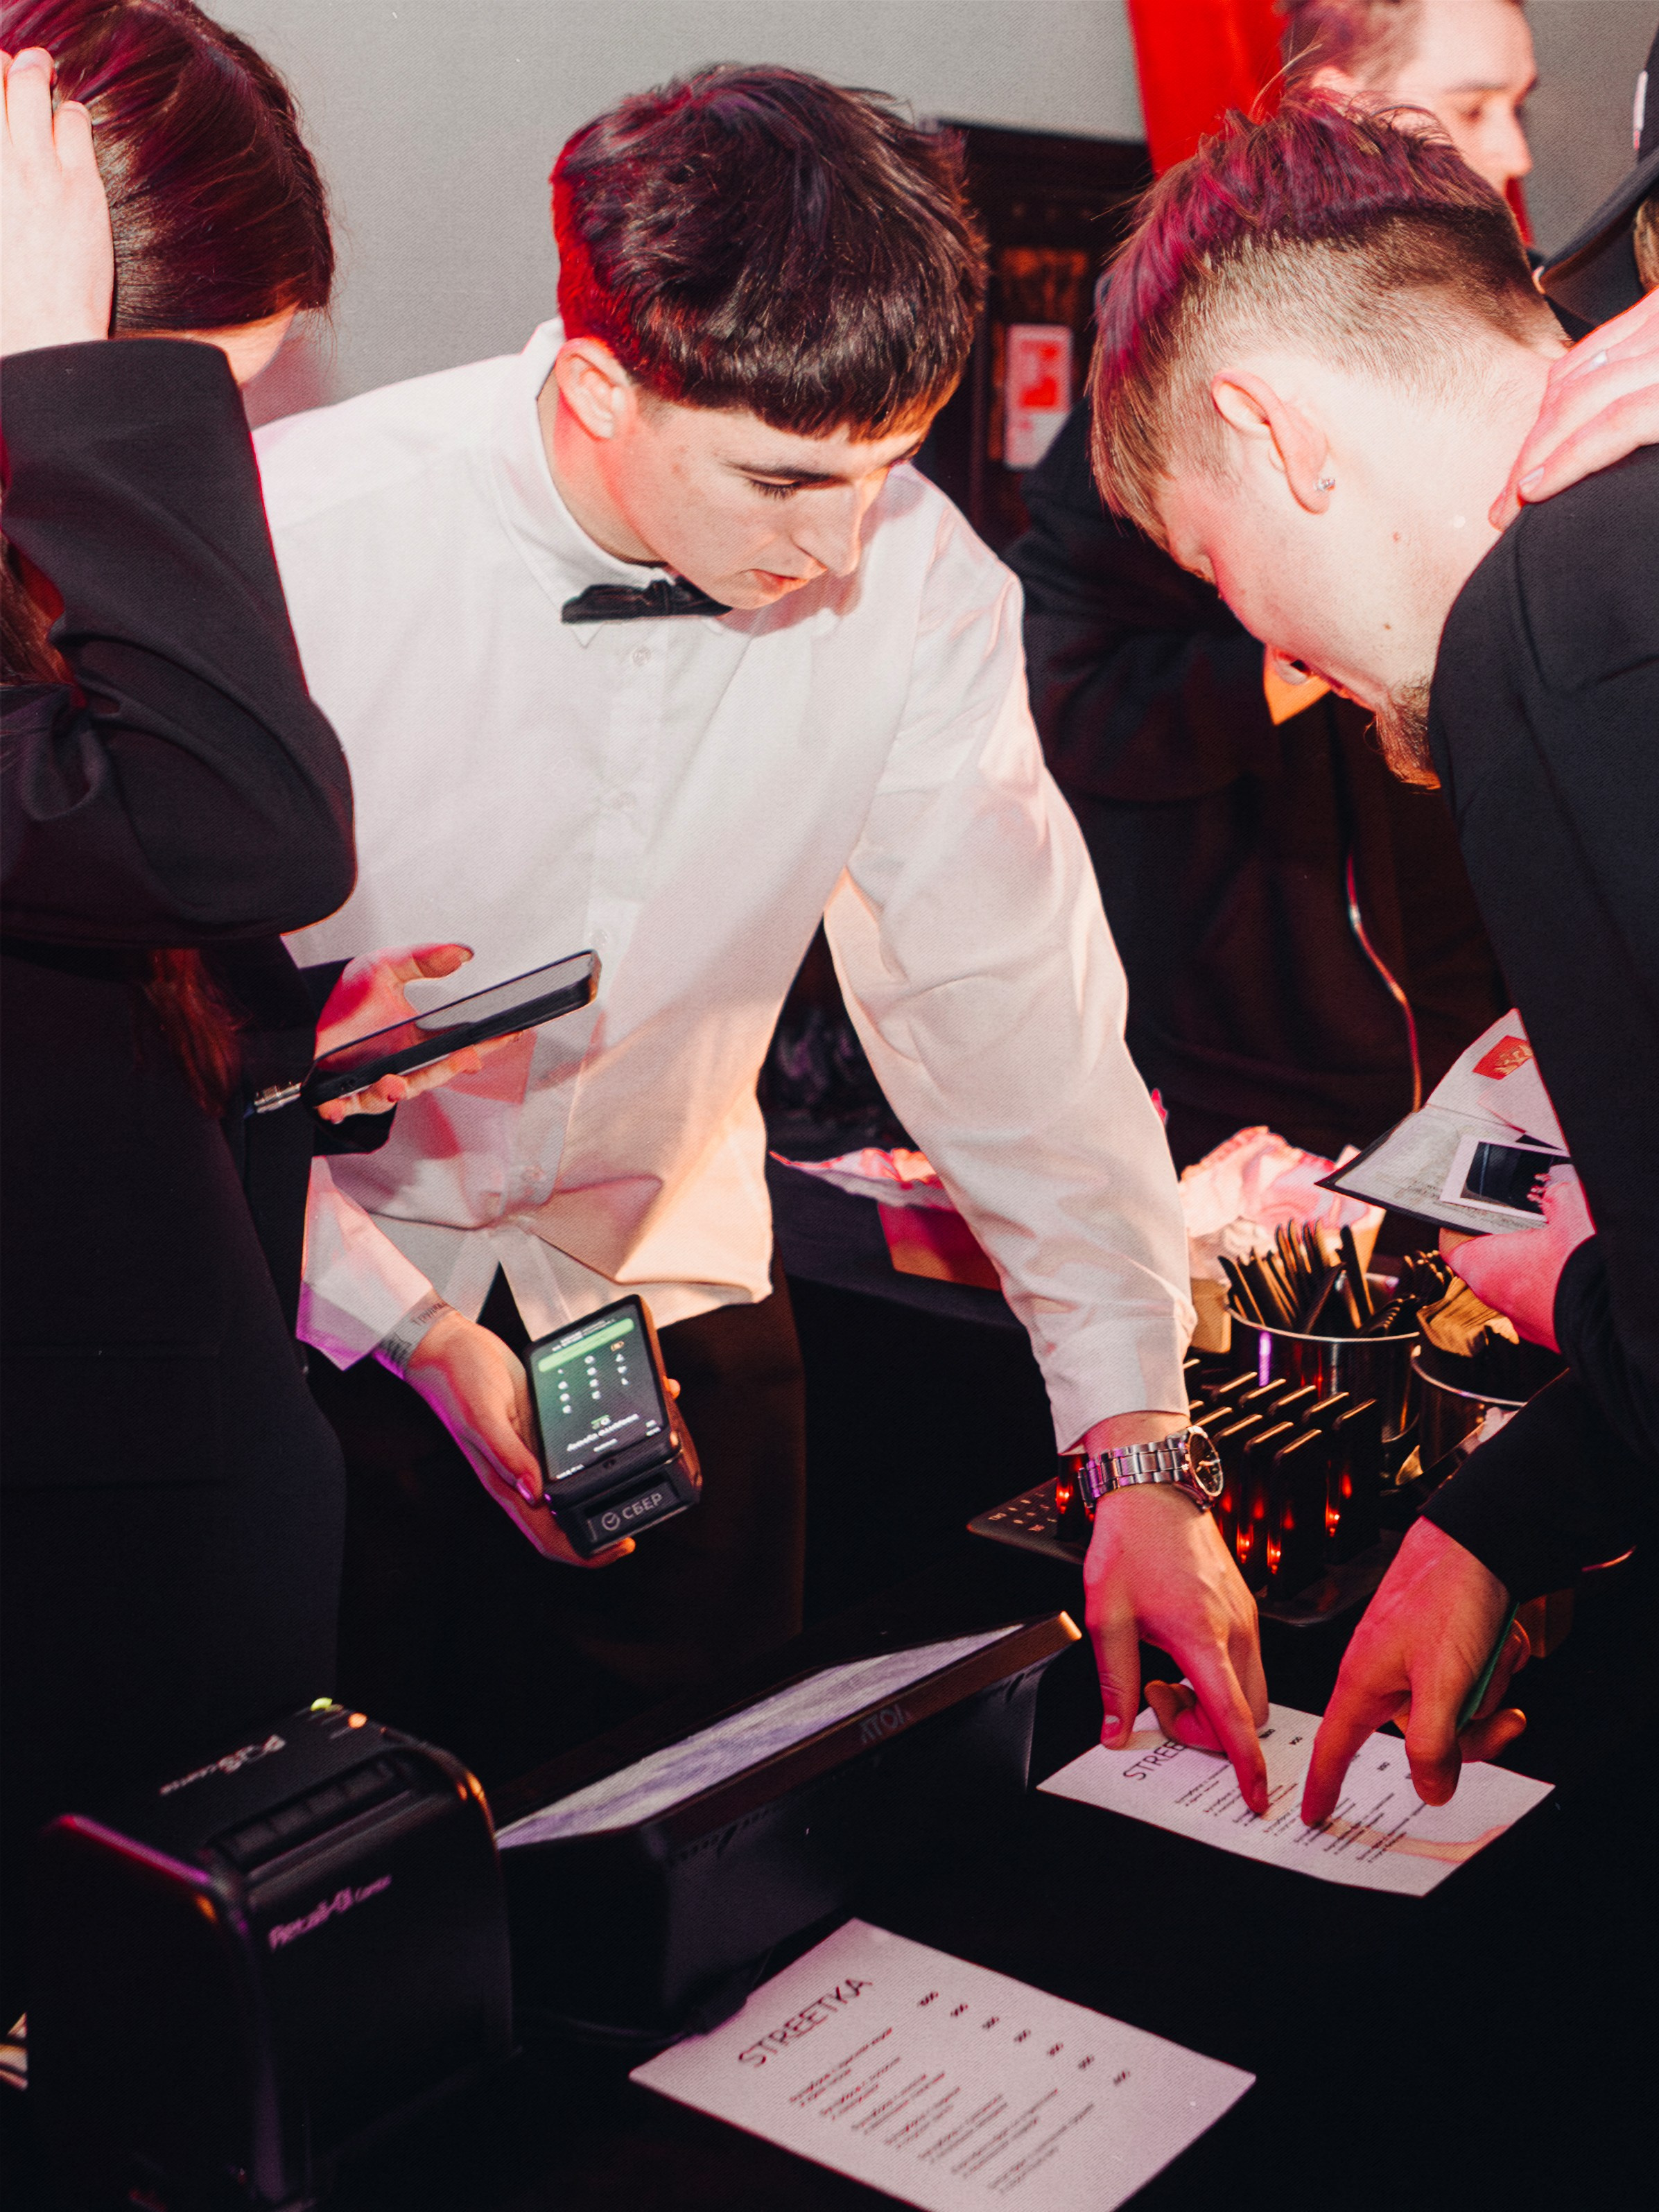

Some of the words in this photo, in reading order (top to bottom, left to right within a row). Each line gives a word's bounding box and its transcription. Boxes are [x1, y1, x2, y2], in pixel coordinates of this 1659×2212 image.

[622, 1492, 663, 1519] СБЕР
[1123, 1738, 1187, 1781] STREE
[738, 1978, 874, 2069] STREETKA
